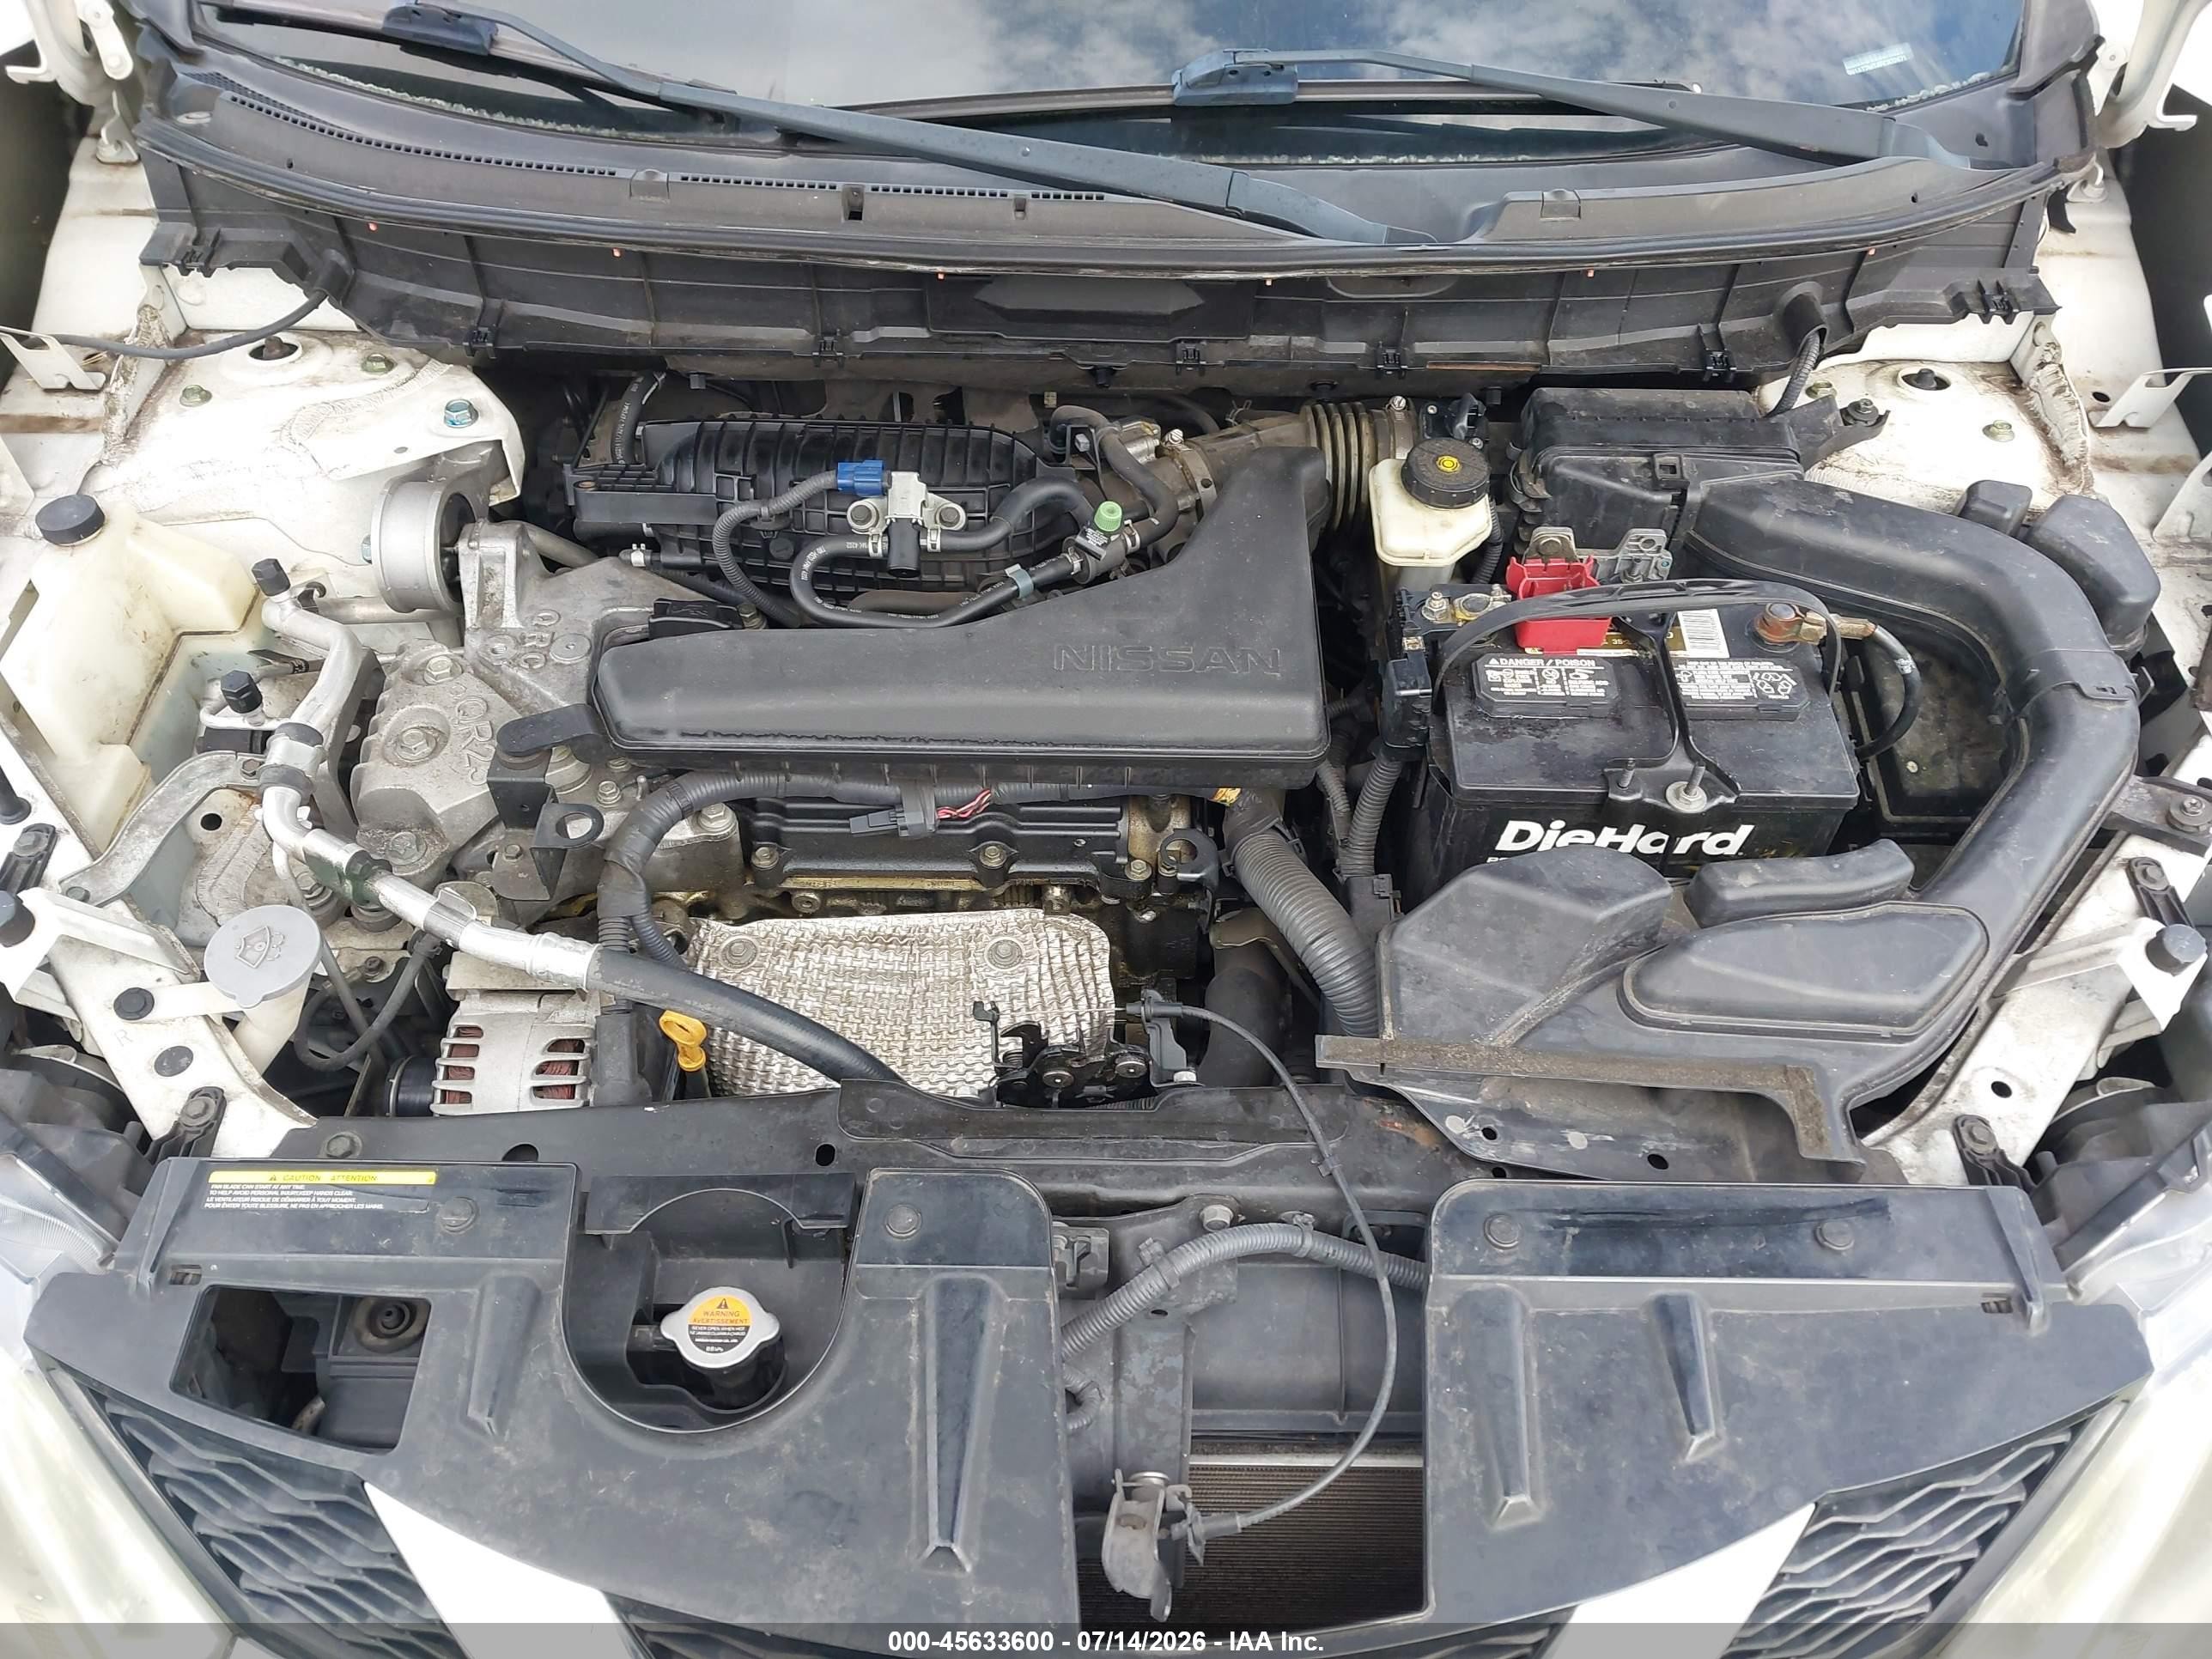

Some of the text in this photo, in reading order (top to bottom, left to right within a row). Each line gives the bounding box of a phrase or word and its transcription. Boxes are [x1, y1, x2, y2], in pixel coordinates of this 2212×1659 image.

[1053, 645, 1282, 677] NISSAN
[1499, 658, 1545, 667] DANGER
[1555, 659, 1595, 668] POISON
[1495, 820, 1755, 855] DieHard
